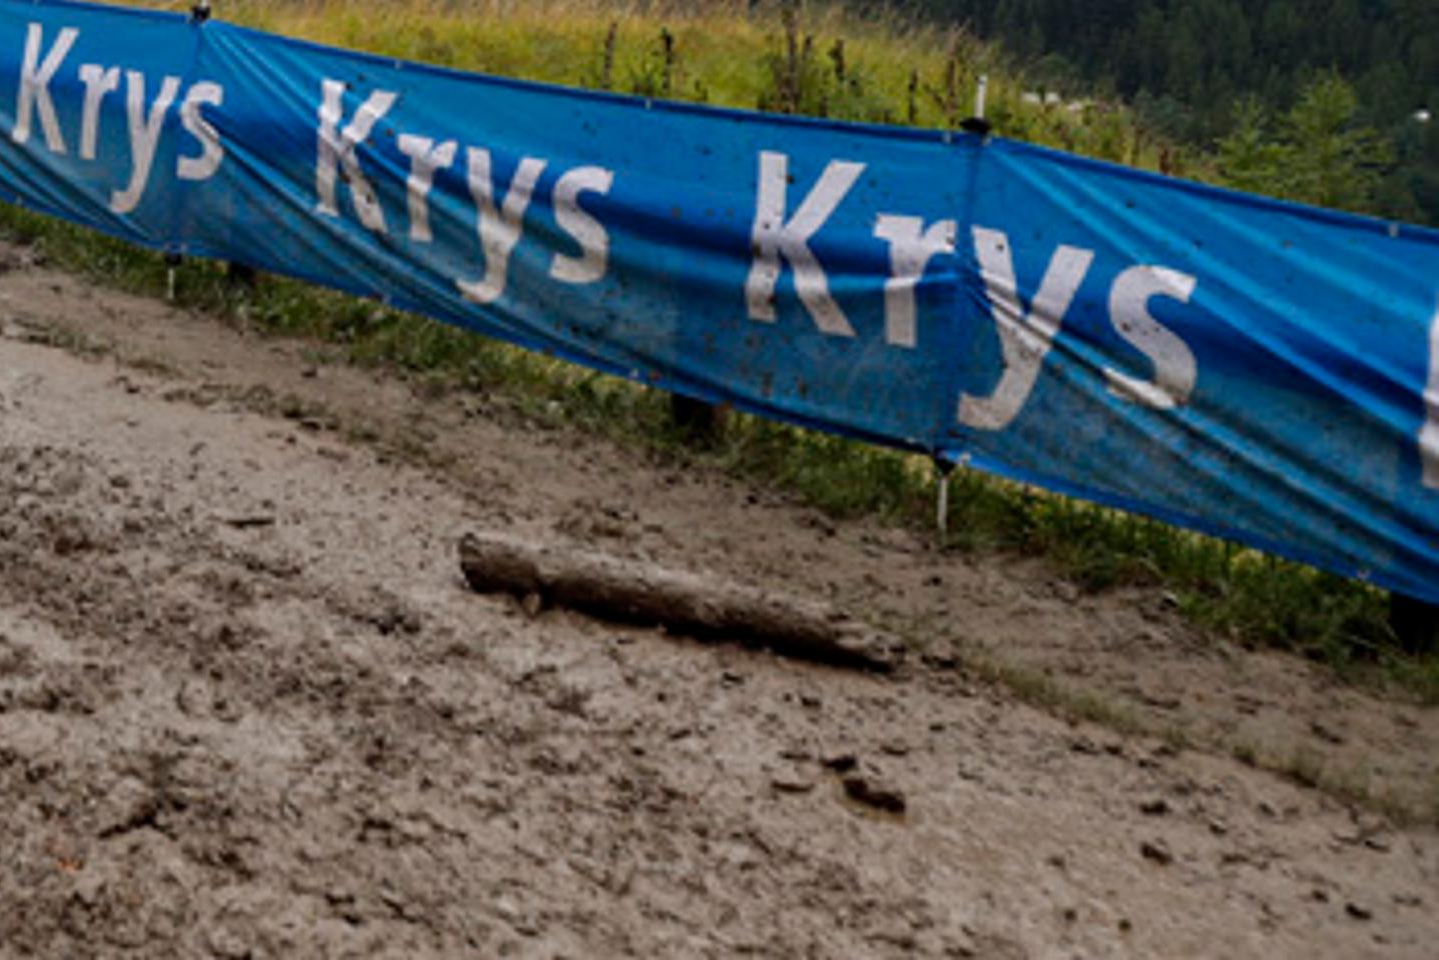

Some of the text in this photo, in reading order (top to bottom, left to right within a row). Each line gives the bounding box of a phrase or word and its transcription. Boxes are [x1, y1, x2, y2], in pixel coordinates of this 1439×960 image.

[11, 22, 224, 213] Krys
[314, 78, 615, 303] Krys
[745, 150, 1197, 431] Krys
